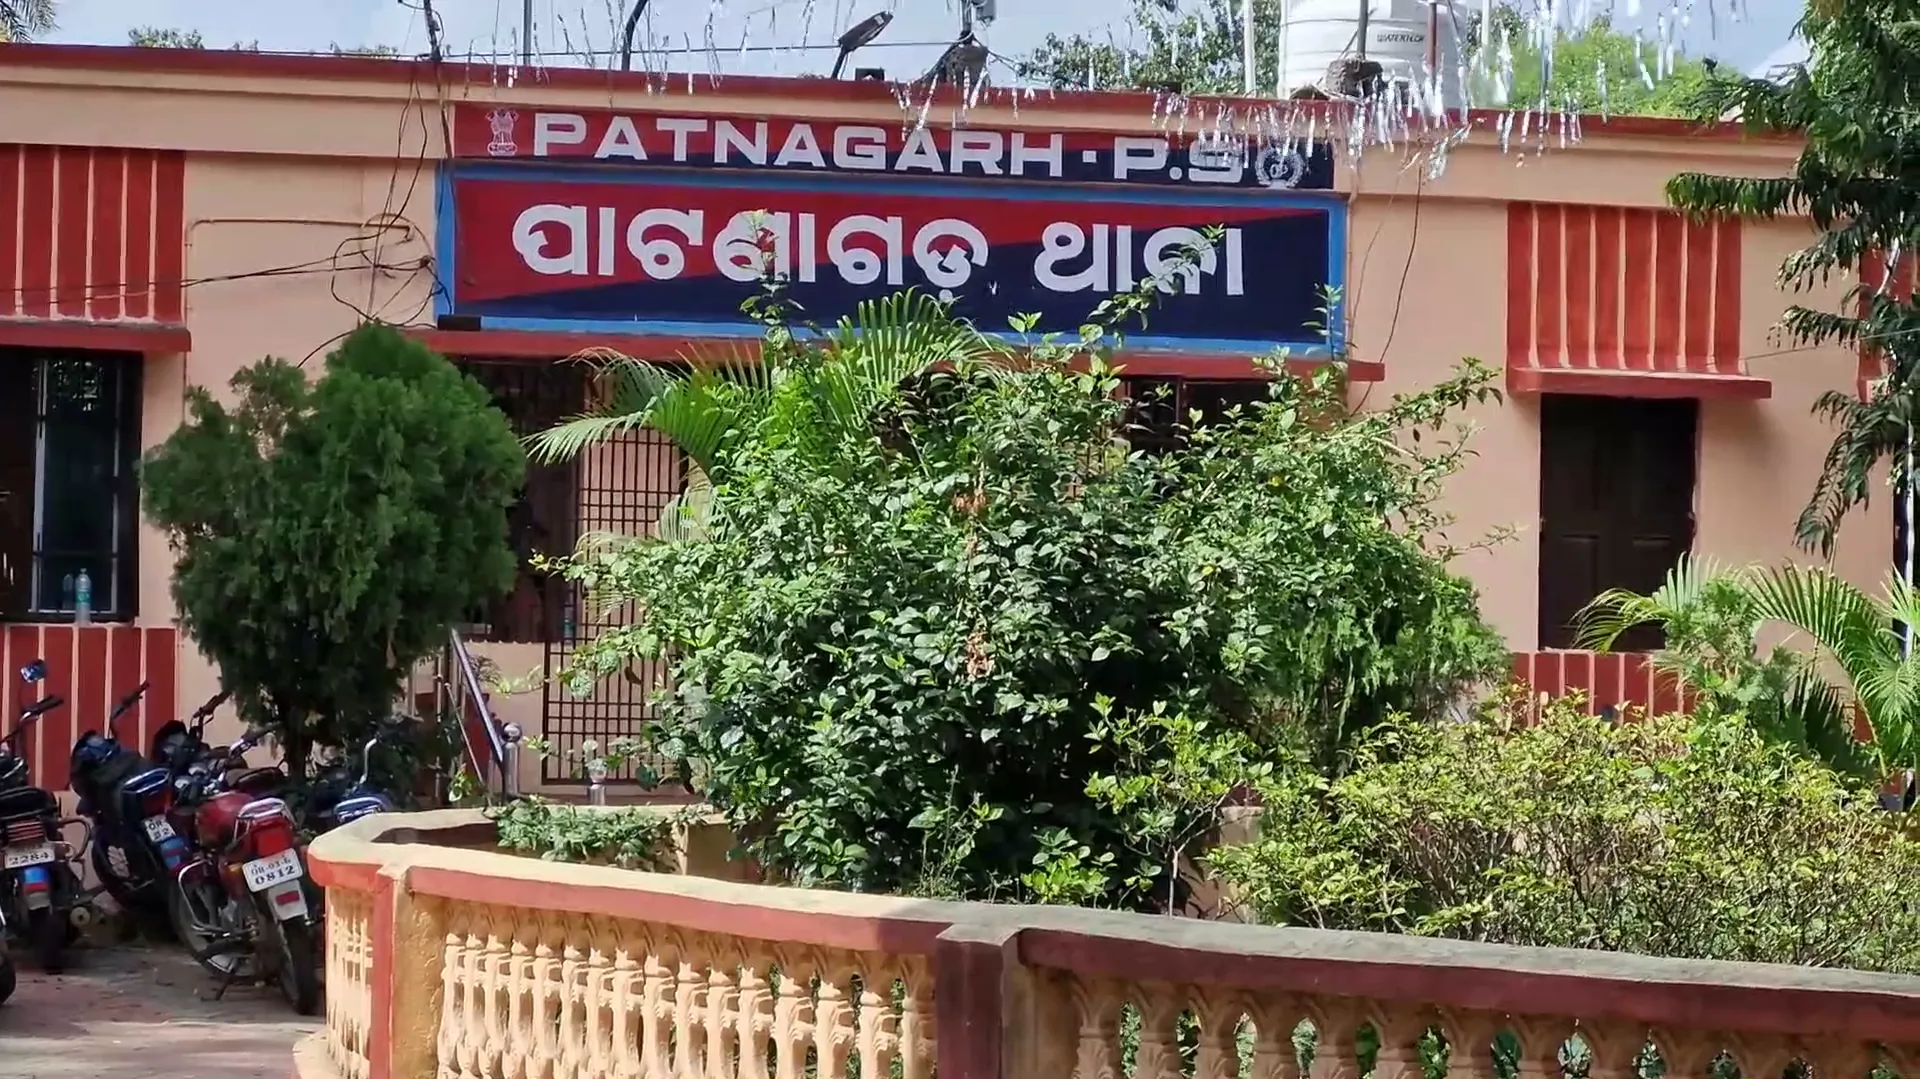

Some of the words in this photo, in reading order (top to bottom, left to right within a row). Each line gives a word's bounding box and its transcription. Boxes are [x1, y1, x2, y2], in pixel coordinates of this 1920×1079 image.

[533, 112, 1064, 178] PATNAGARH
[1034, 221, 1244, 297] ଥାନା
[9, 851, 49, 865] 2284
[255, 865, 295, 885] 0812
